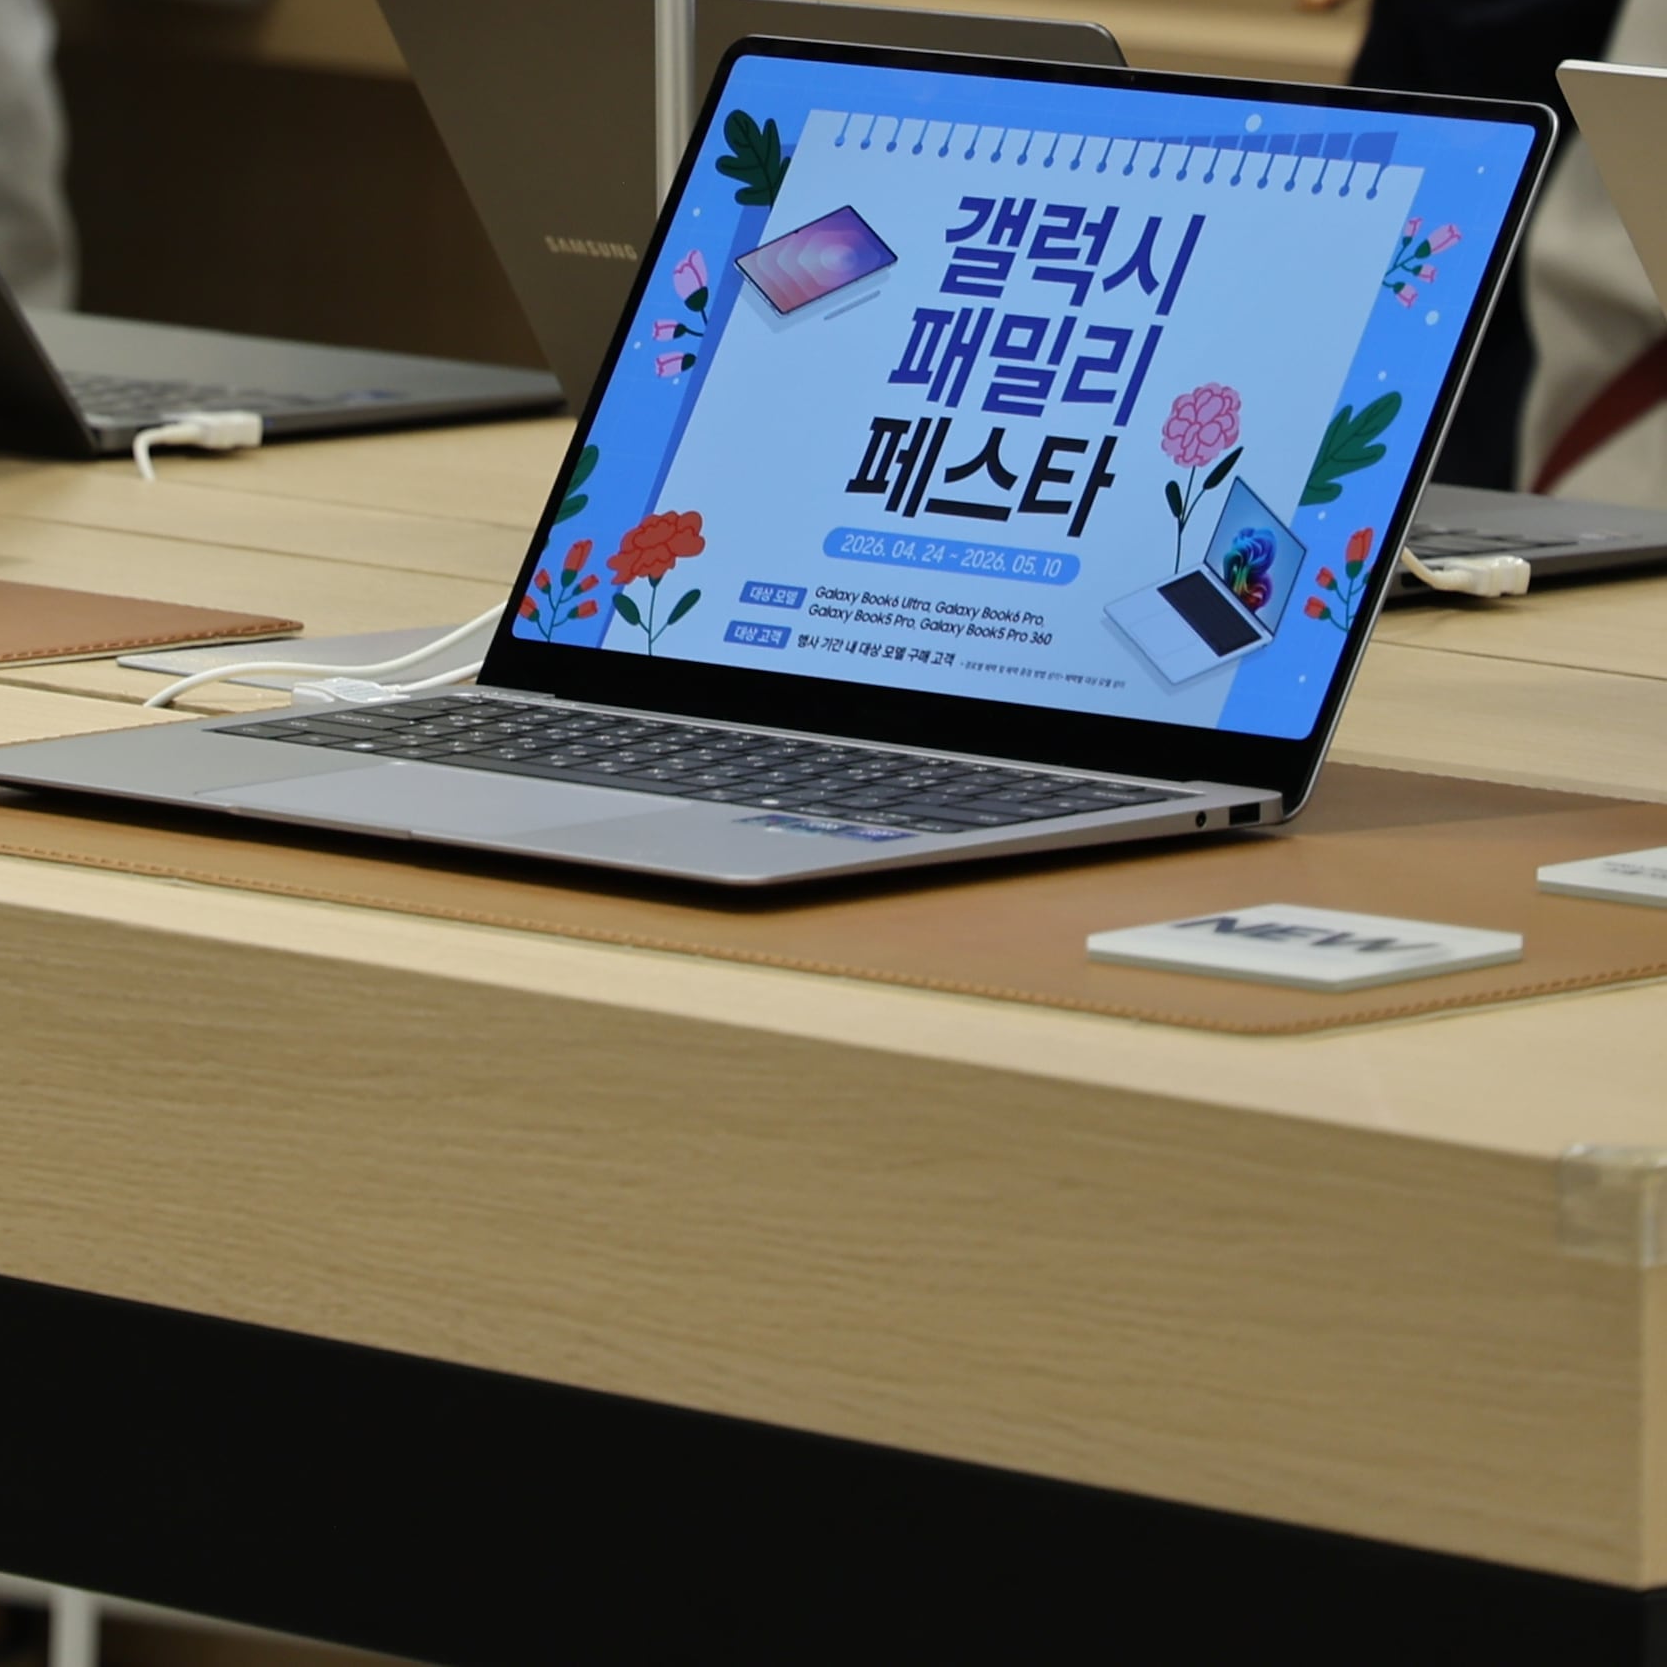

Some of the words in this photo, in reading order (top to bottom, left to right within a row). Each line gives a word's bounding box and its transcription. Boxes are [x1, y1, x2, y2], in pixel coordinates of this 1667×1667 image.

[545, 234, 638, 261] SAMSUNG
[940, 195, 1206, 316] 갤럭시
[887, 307, 1164, 427] 패밀리
[845, 416, 1118, 538] 페스타
[840, 534, 886, 557] 2026.
[891, 541, 916, 561] 04.
[921, 544, 945, 563] 24
[960, 548, 1007, 572] 2026.
[1012, 555, 1037, 575] 05.
[1043, 557, 1062, 578] 10
[808, 603, 853, 624] Galaxy
[854, 609, 894, 625] Book5
[919, 617, 965, 638] Galaxy
[965, 623, 1005, 639] Book5
[1006, 629, 1029, 644] Pro
[1029, 631, 1053, 646] 360
[814, 585, 860, 607] Galaxy
[860, 591, 900, 608] Book6
[934, 601, 981, 621] Galaxy
[981, 606, 1020, 623] Book6
[1021, 612, 1045, 628] Pro,
[821, 637, 845, 654] 기간
[845, 640, 858, 655] 내
[858, 641, 883, 659] 대상
[907, 648, 931, 665] 구매
[930, 651, 956, 668] 고객
[1169, 914, 1441, 955] NEW
